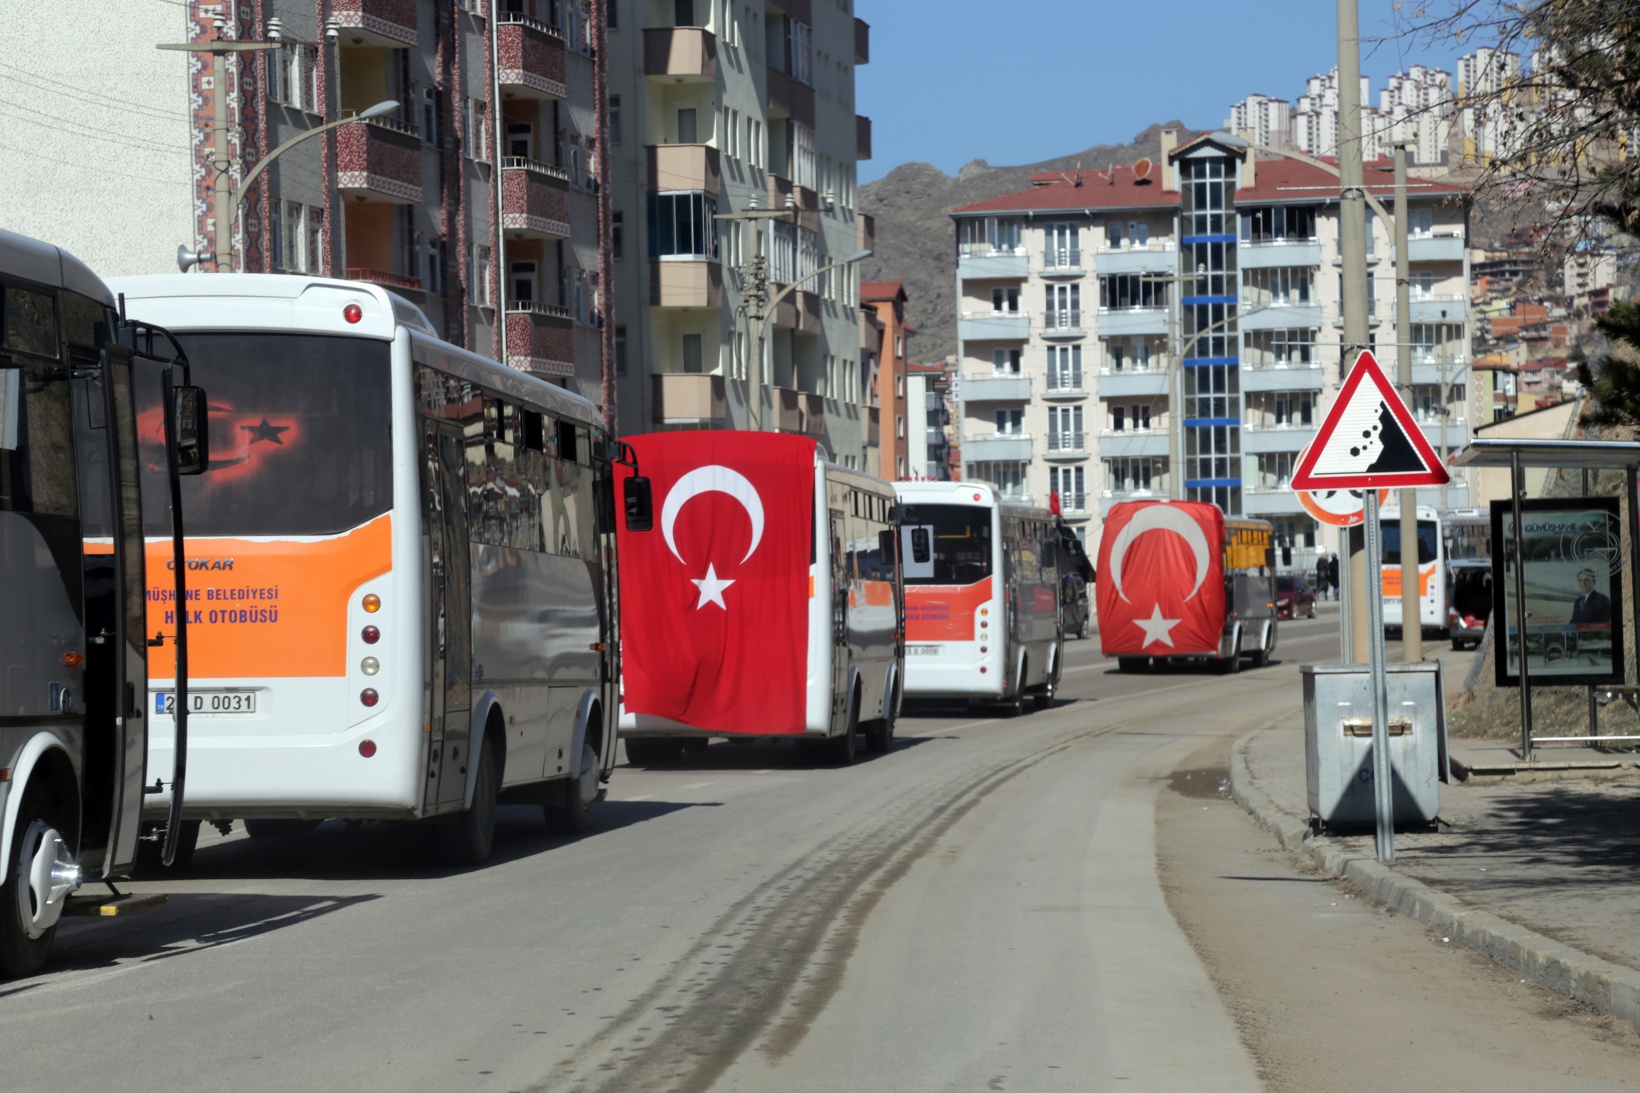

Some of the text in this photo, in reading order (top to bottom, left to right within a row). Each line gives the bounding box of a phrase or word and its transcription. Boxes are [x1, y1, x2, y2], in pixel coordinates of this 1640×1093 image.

[207, 585, 278, 600] BELEDİYESİ
[165, 605, 278, 624] HLK OTOBÜSÜ
[194, 696, 203, 710] D
[212, 695, 251, 710] 0031
